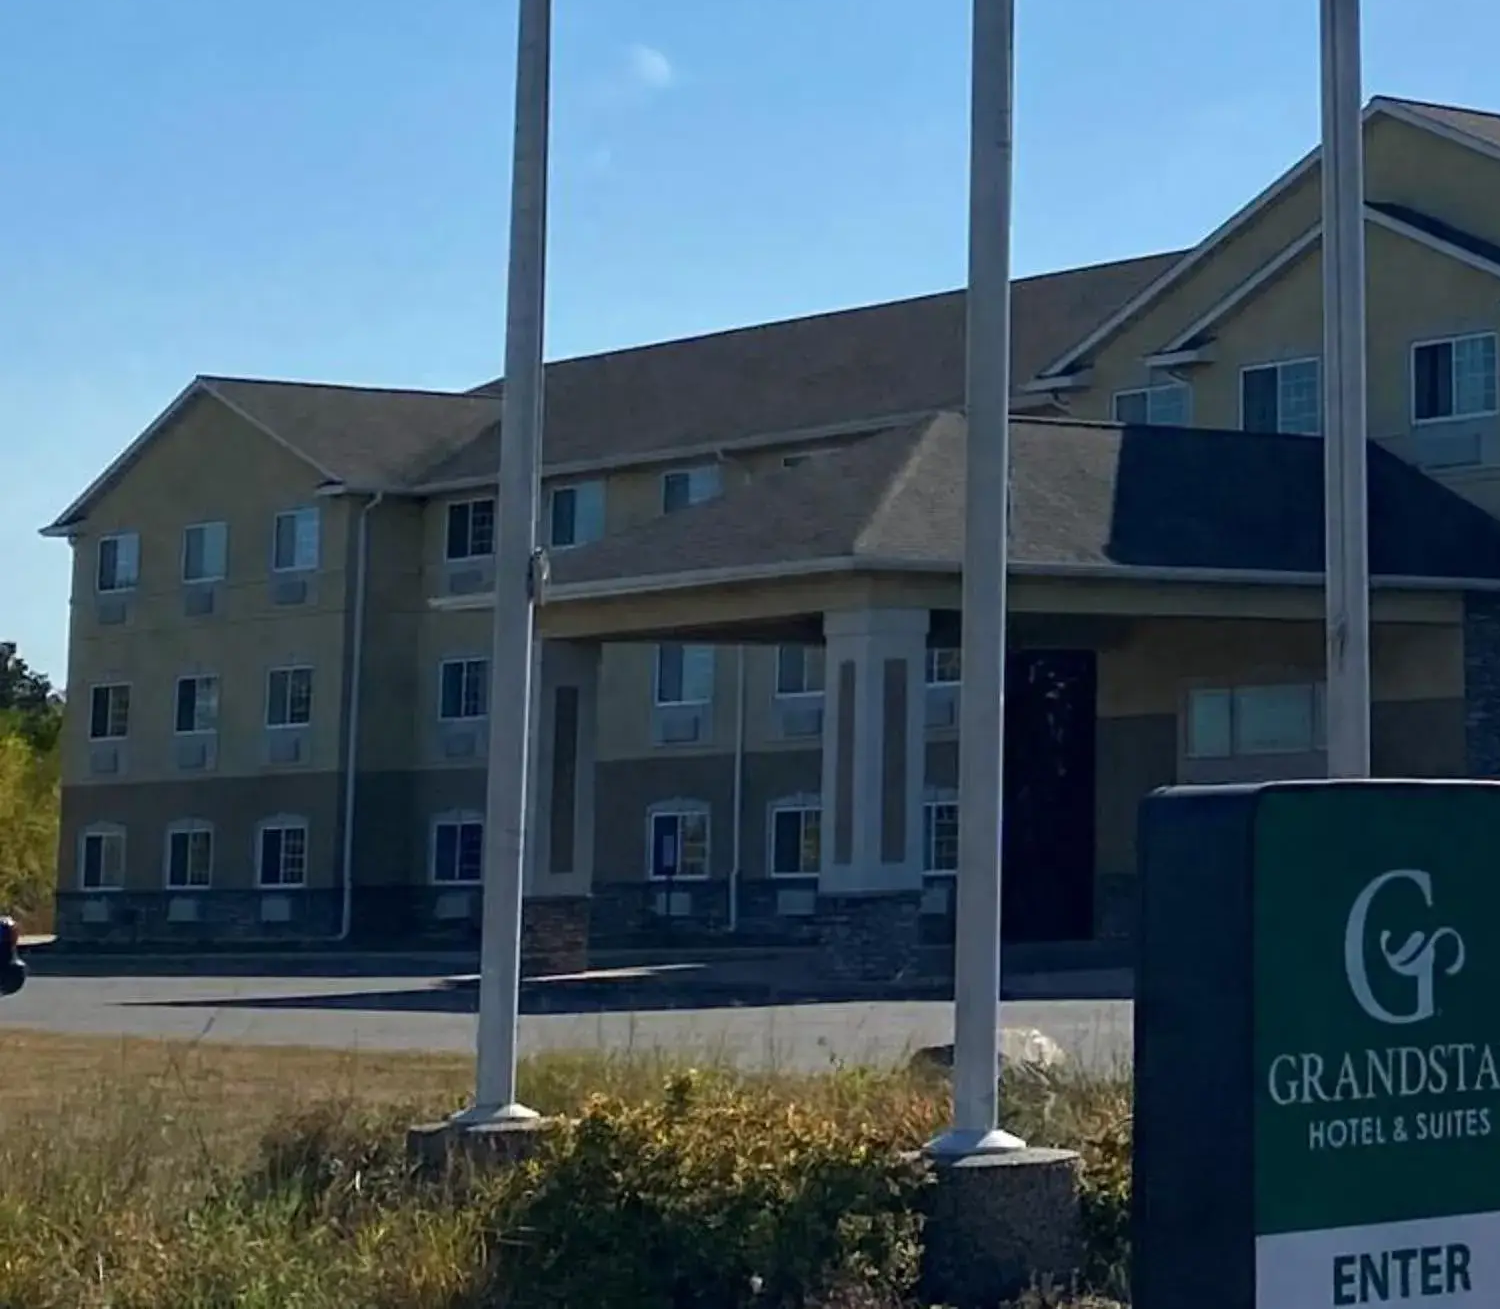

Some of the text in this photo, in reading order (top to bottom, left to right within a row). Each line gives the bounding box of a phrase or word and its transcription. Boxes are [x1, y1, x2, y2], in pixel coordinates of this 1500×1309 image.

[1309, 1108, 1491, 1150] HOTEL & SUITES
[1333, 1243, 1472, 1306] ENTER
